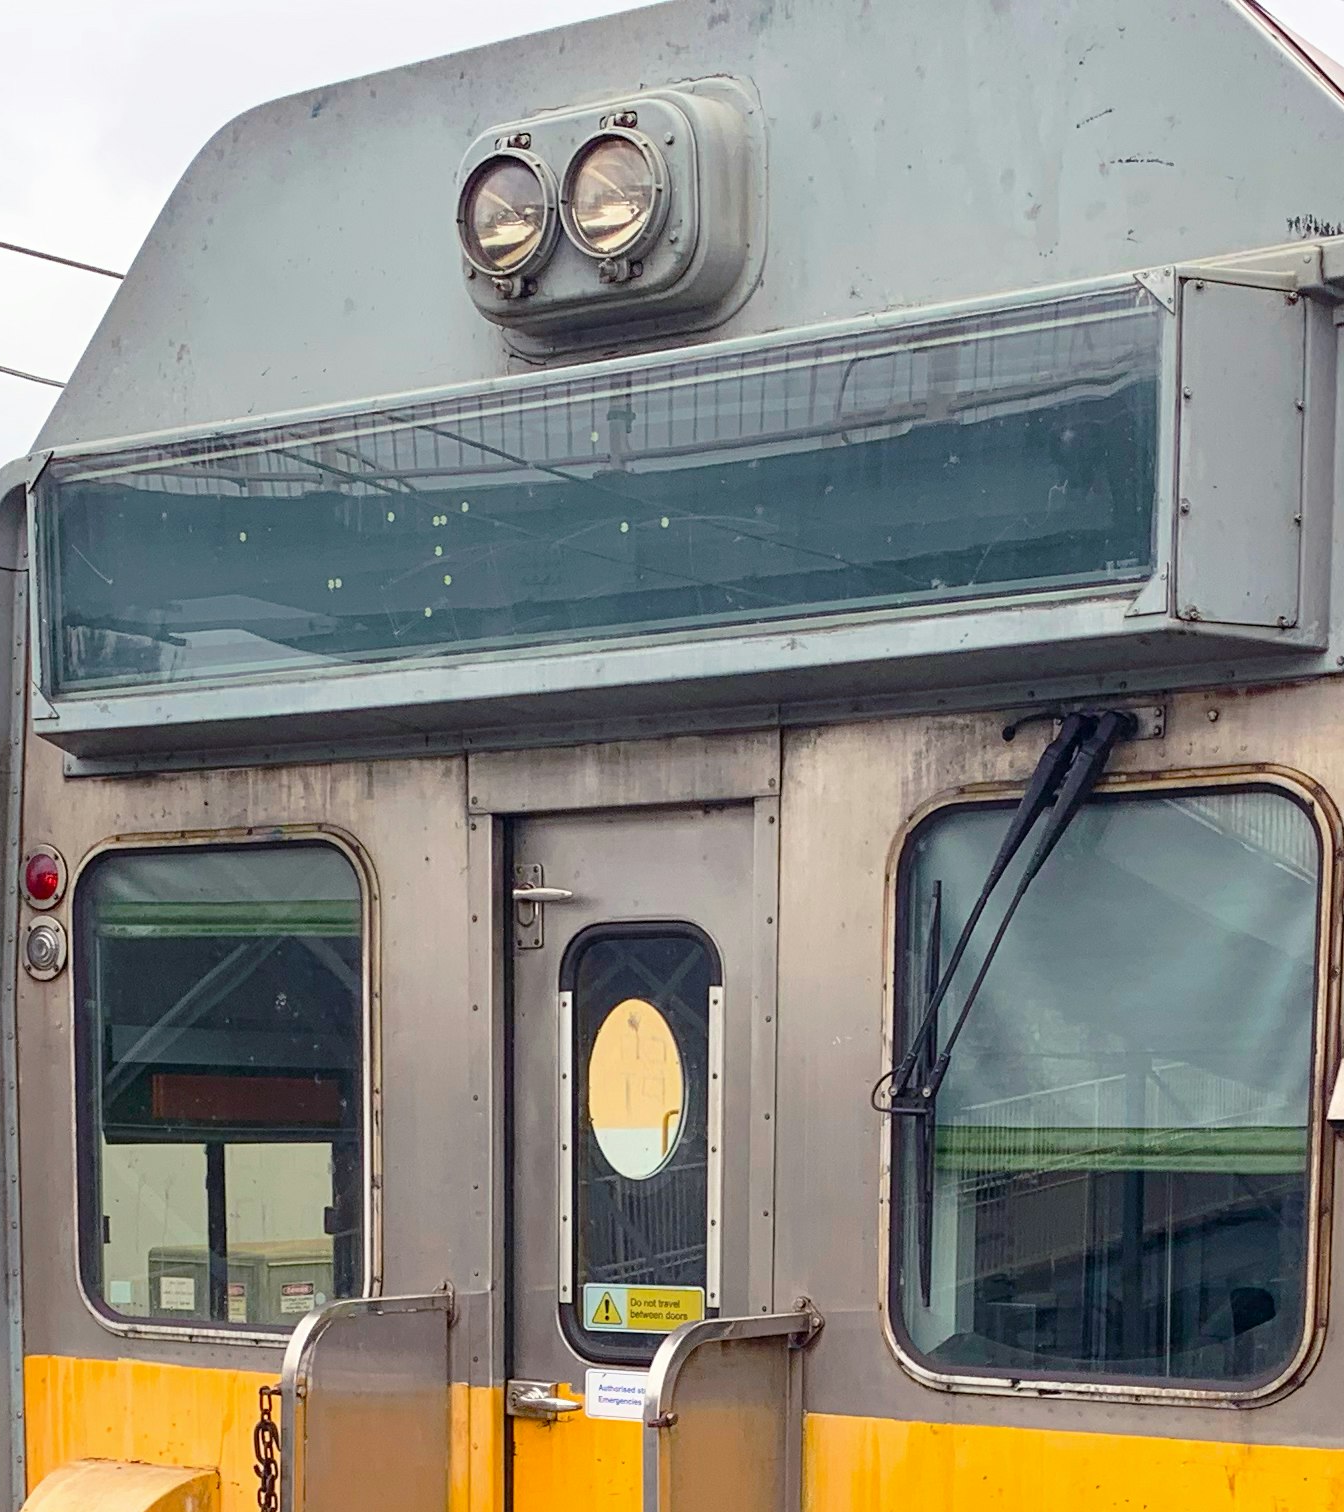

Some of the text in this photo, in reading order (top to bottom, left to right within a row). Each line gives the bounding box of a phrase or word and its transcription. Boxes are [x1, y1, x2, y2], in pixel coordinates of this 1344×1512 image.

[630, 1298, 680, 1308] Do not travel
[630, 1309, 688, 1320] between doors
